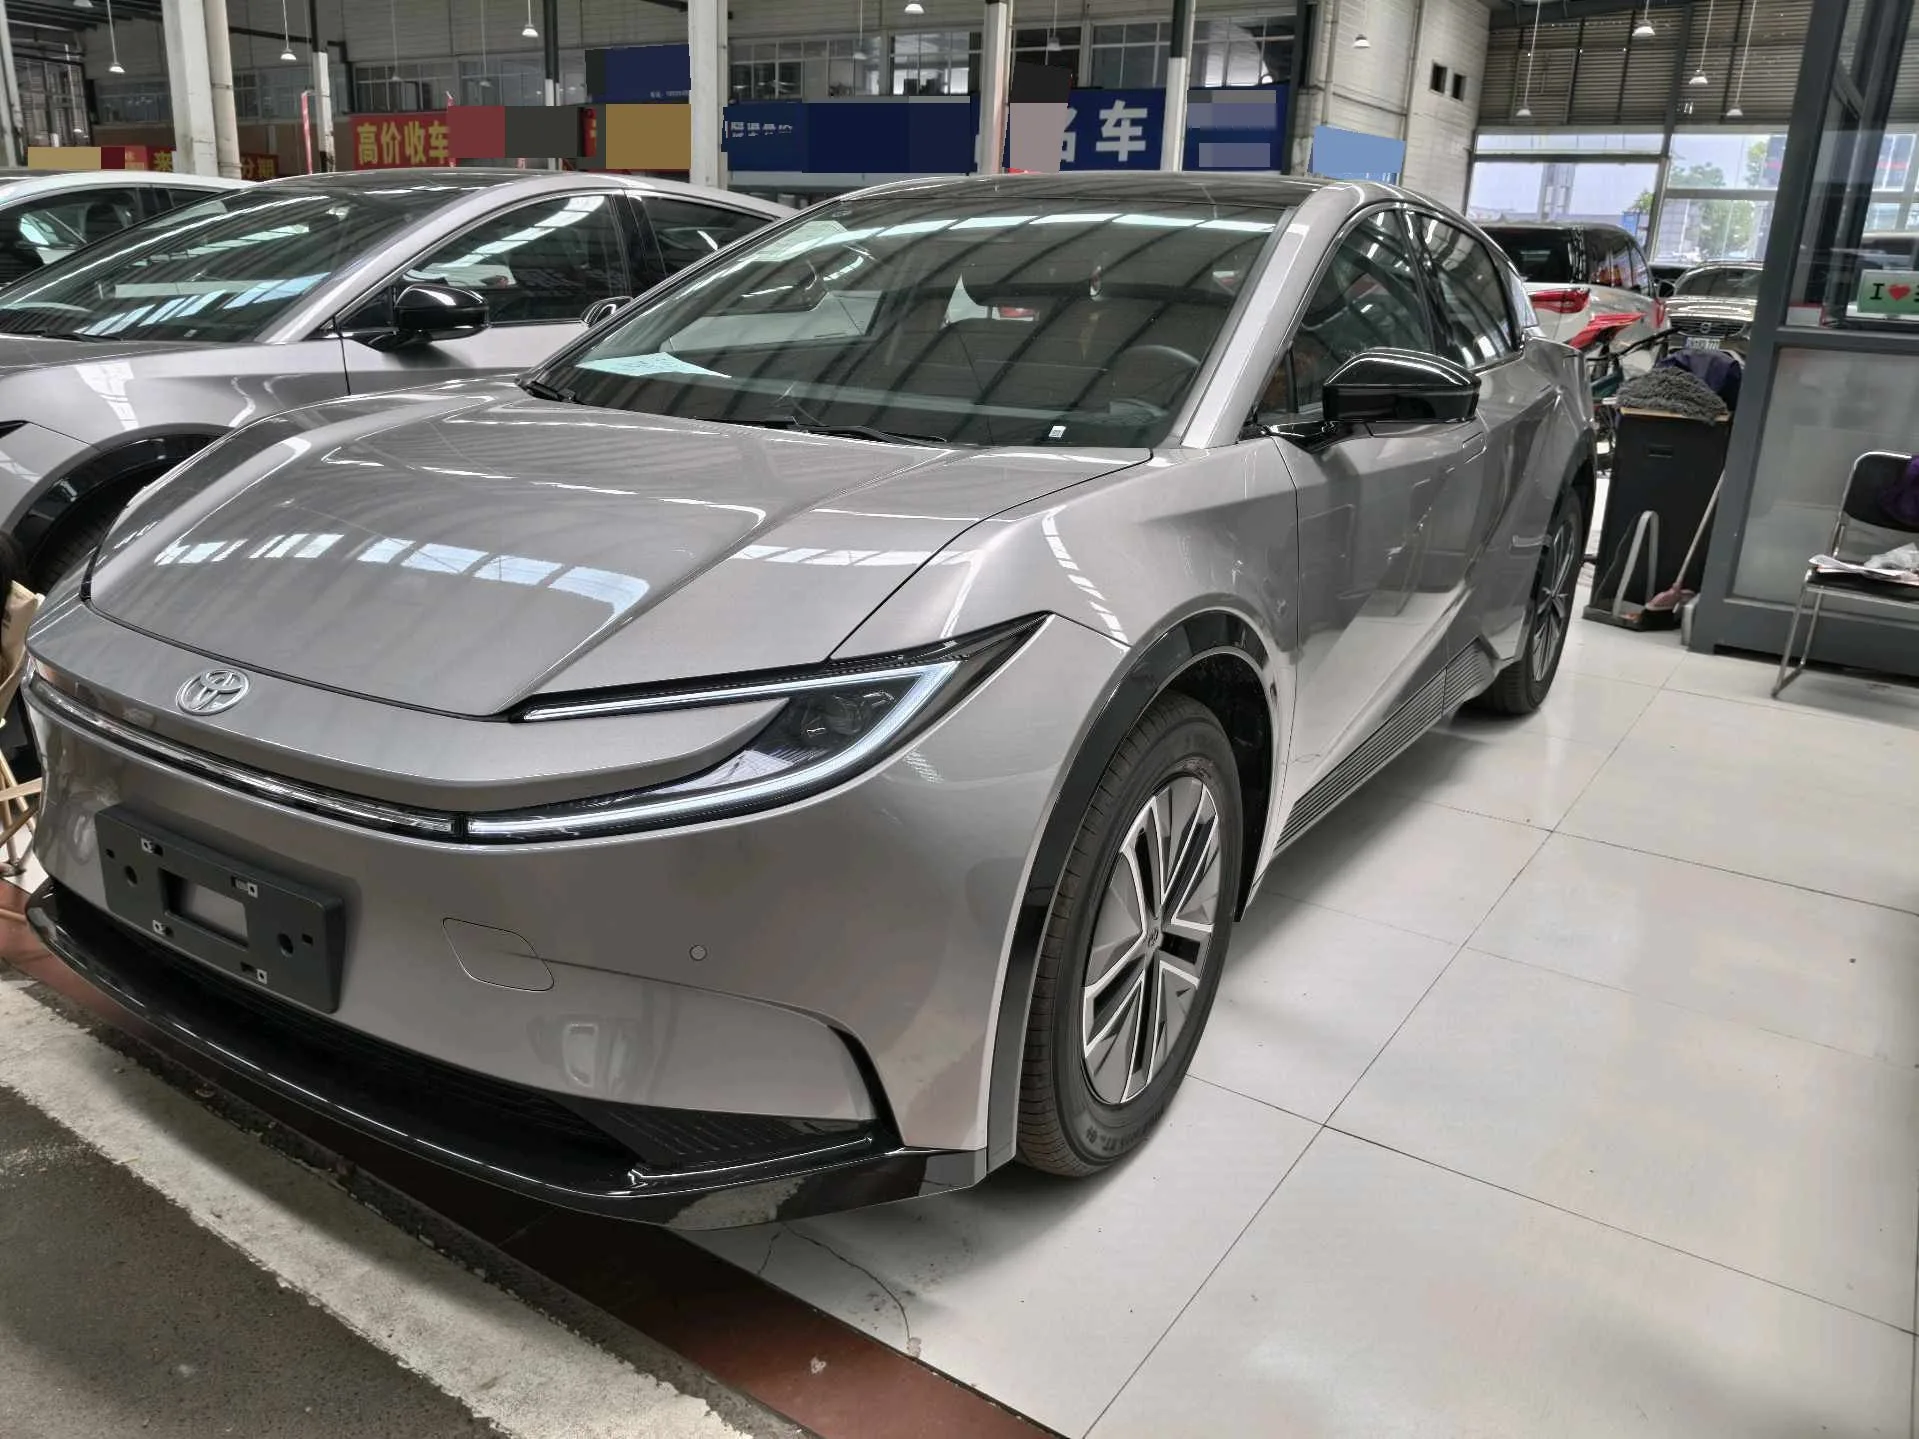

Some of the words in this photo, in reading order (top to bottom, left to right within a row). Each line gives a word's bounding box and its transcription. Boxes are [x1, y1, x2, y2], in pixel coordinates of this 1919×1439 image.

[357, 120, 450, 165] 高价收车
[1869, 282, 1885, 300] I
